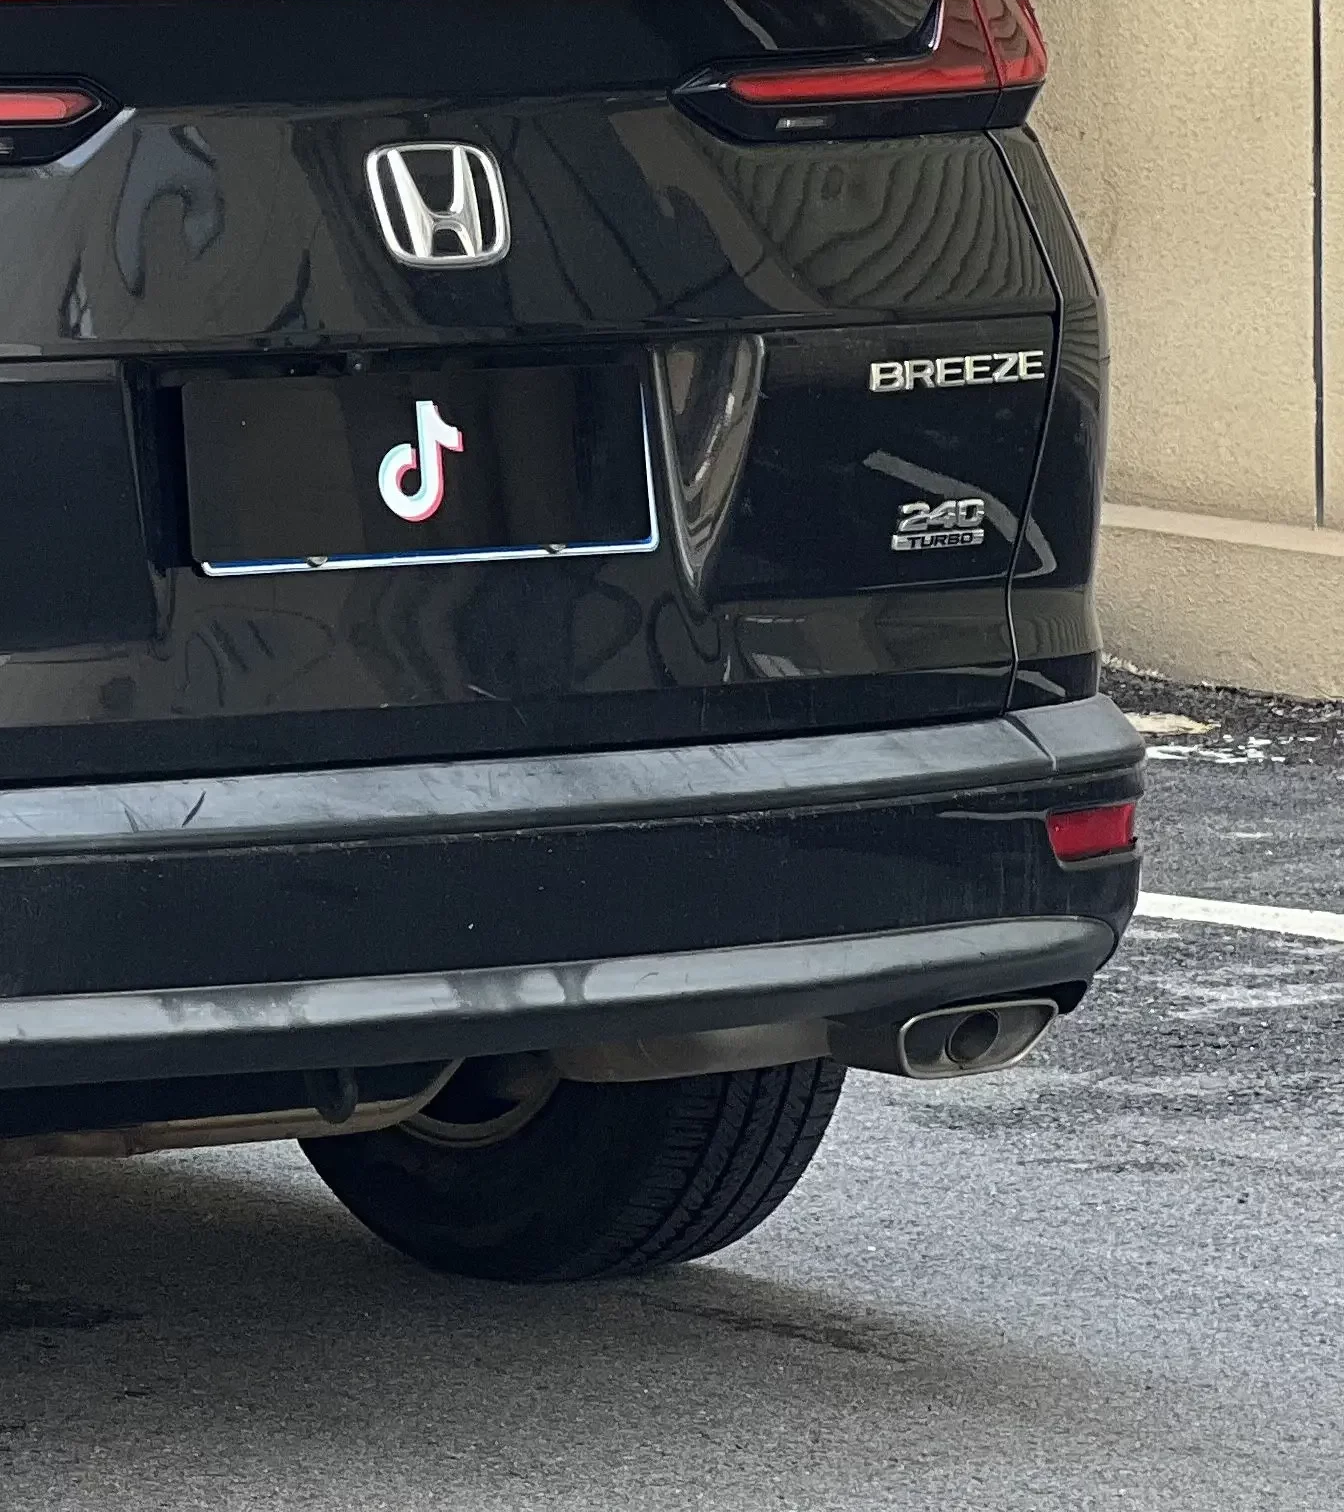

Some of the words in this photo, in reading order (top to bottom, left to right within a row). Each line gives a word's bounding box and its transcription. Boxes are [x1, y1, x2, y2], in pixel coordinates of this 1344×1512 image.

[869, 350, 1046, 393] BREEZE
[897, 498, 985, 532] 240
[907, 531, 975, 549] TURBO
